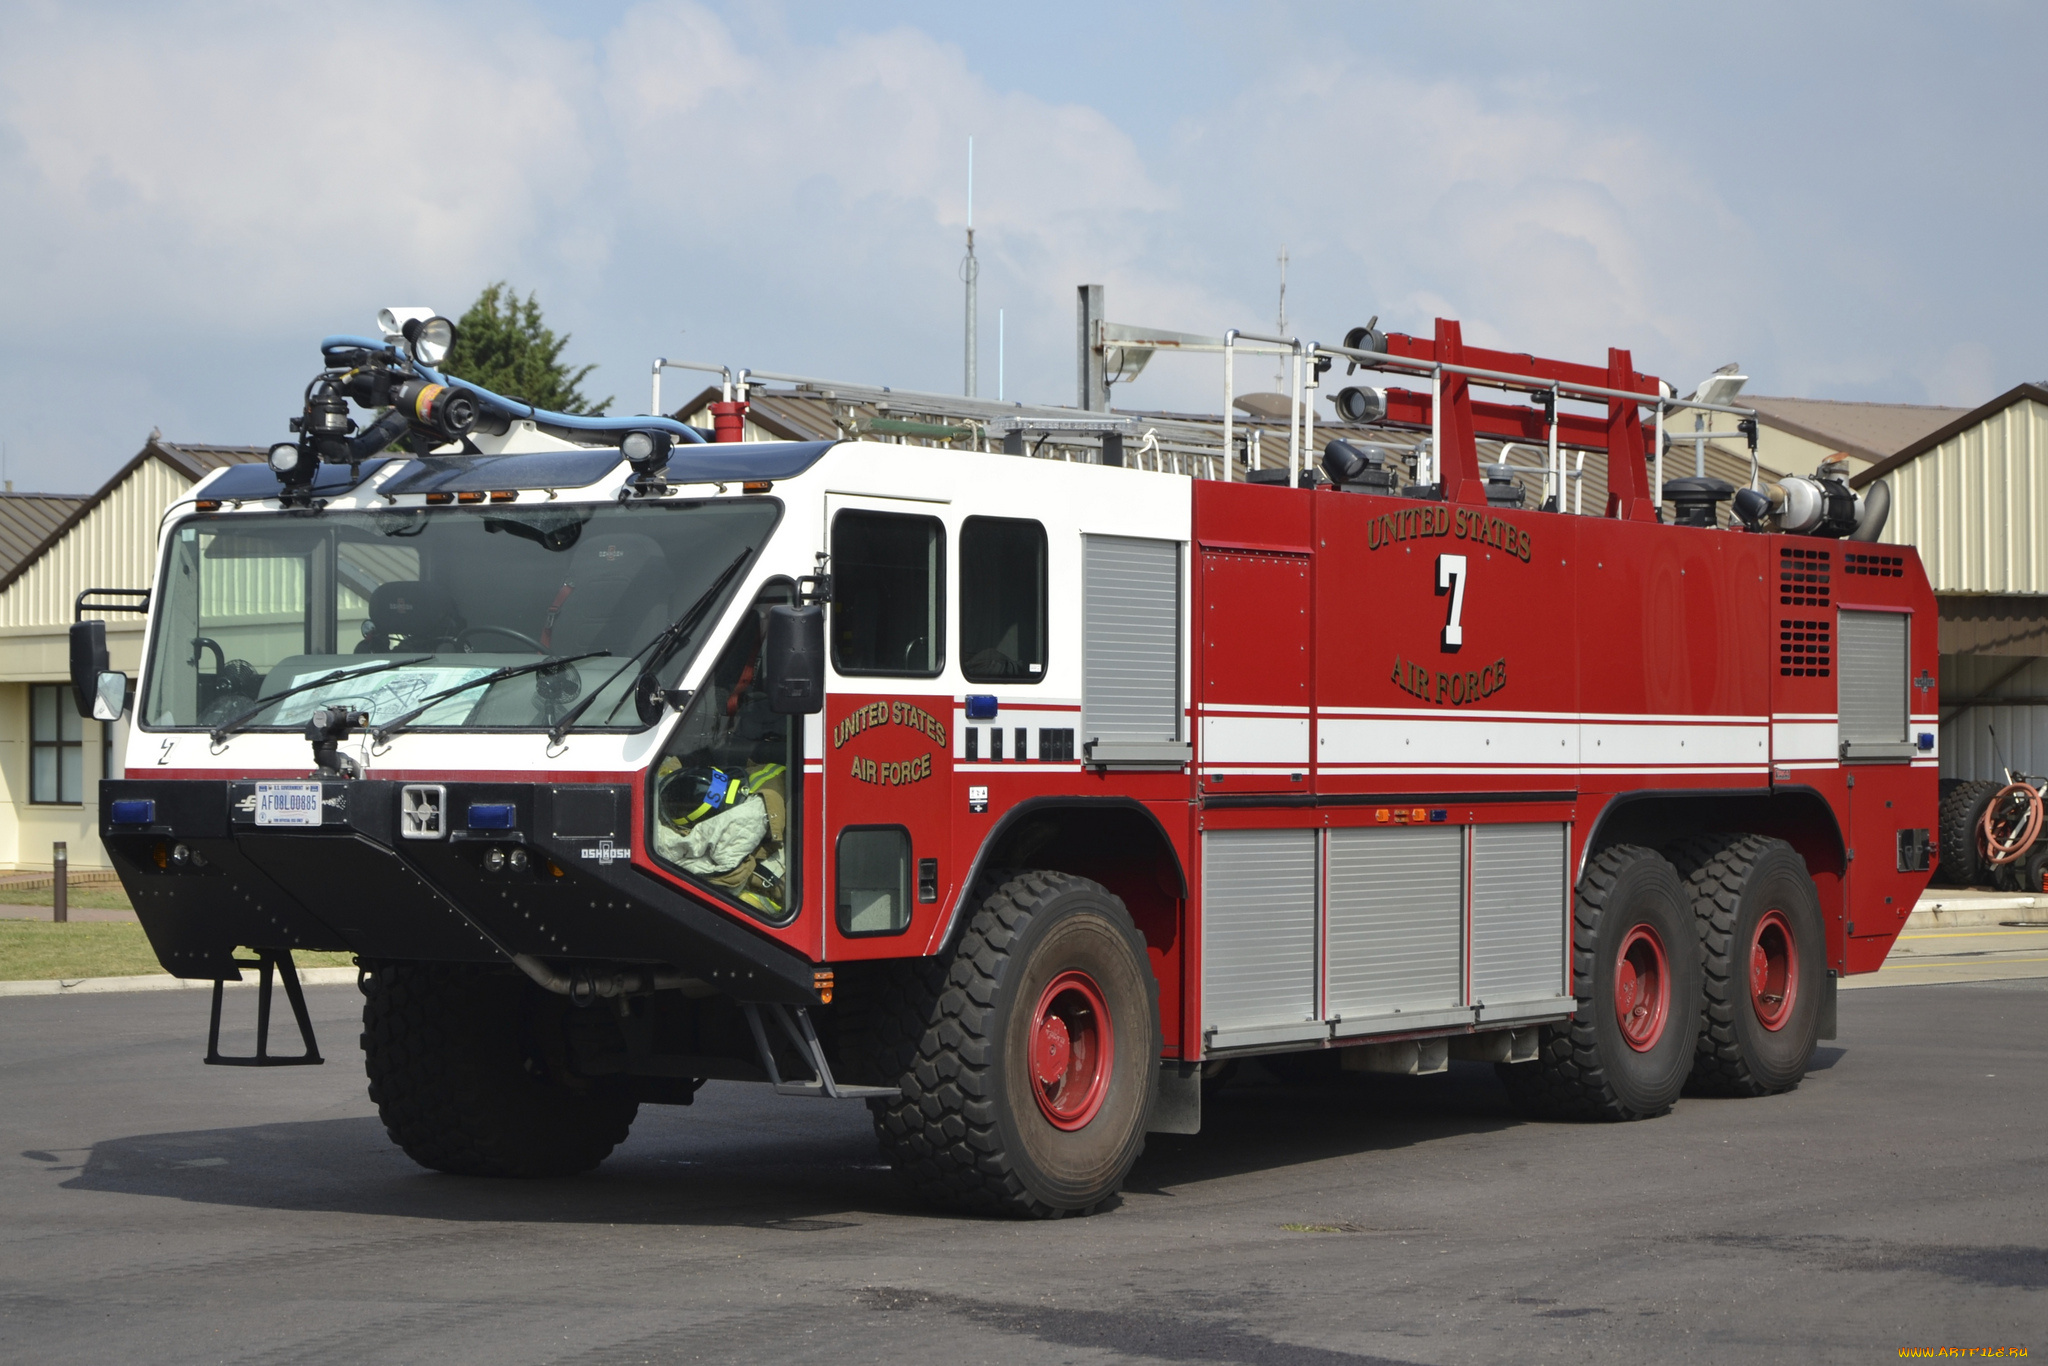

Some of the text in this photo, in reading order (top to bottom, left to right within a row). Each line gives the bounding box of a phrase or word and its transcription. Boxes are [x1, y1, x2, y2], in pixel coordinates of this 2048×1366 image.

[1367, 506, 1531, 563] UNITED STATES
[1435, 554, 1467, 654] 7
[1391, 654, 1507, 705] AIR FORCE
[834, 700, 946, 749] UNITED STATES
[851, 753, 931, 786] AIR FORCE
[261, 794, 317, 810] AF08L00885
[581, 849, 631, 859] OSHKOSH
